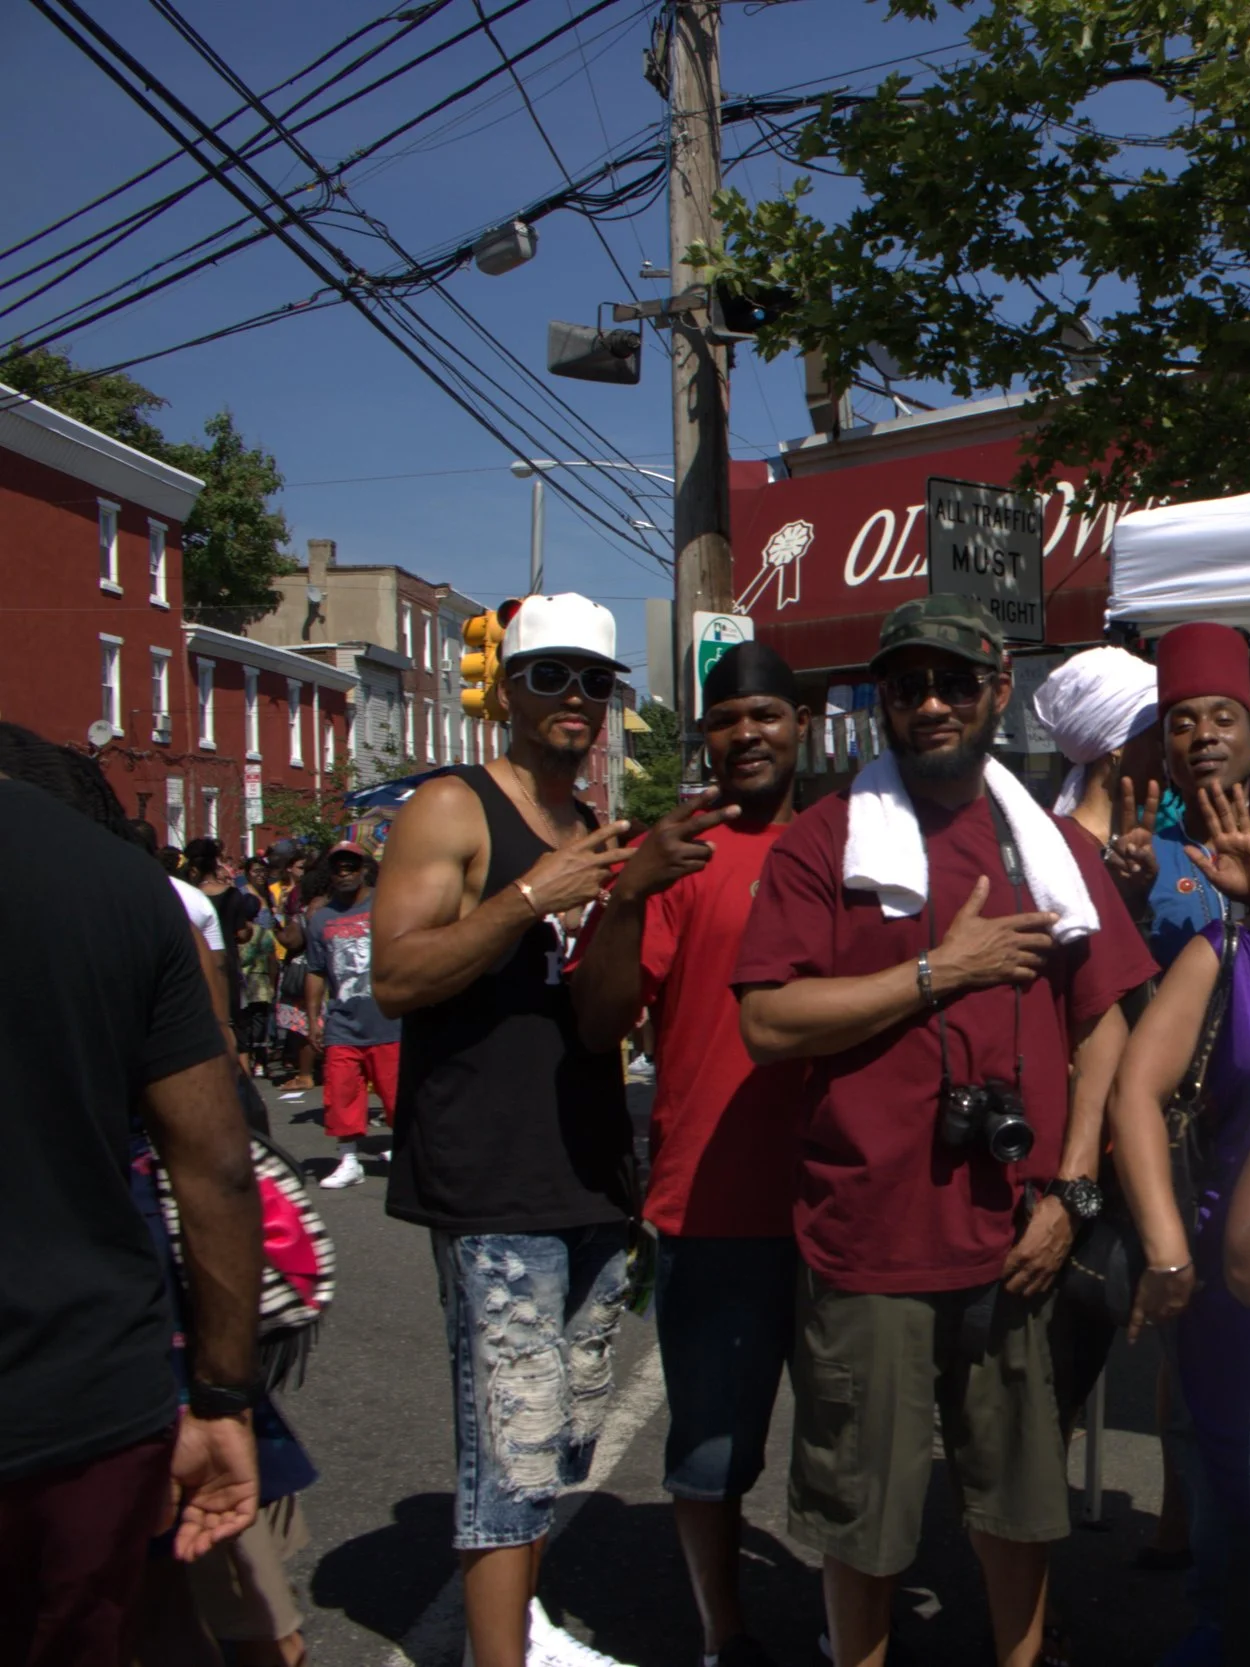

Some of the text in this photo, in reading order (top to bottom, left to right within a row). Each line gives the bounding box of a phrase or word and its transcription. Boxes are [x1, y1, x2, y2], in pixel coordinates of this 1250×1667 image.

[935, 499, 1037, 534] ALL TRAFFIC
[844, 504, 928, 586] OL
[953, 544, 1021, 578] MUST
[990, 598, 1037, 625] RIGHT
